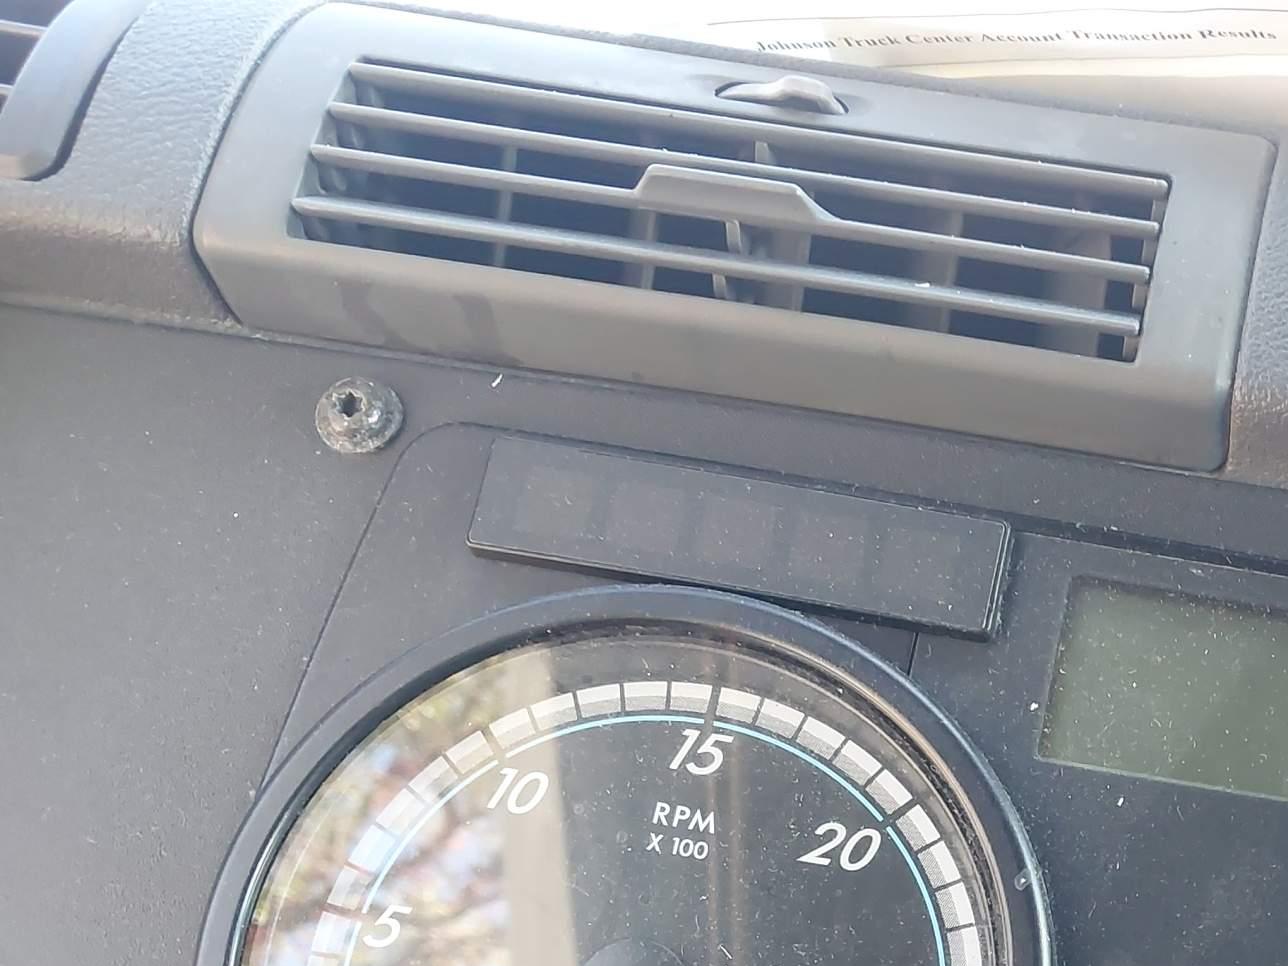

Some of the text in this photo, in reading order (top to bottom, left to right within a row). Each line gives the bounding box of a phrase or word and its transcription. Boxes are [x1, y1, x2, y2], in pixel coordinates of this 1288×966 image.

[757, 29, 1278, 52] Johnson Truck Center Account Transaction Results
[669, 728, 734, 775] 15
[487, 767, 550, 815] 10
[652, 801, 715, 834] RPM
[646, 832, 709, 860] X 100
[796, 821, 882, 871] 20
[362, 904, 412, 948] 5
